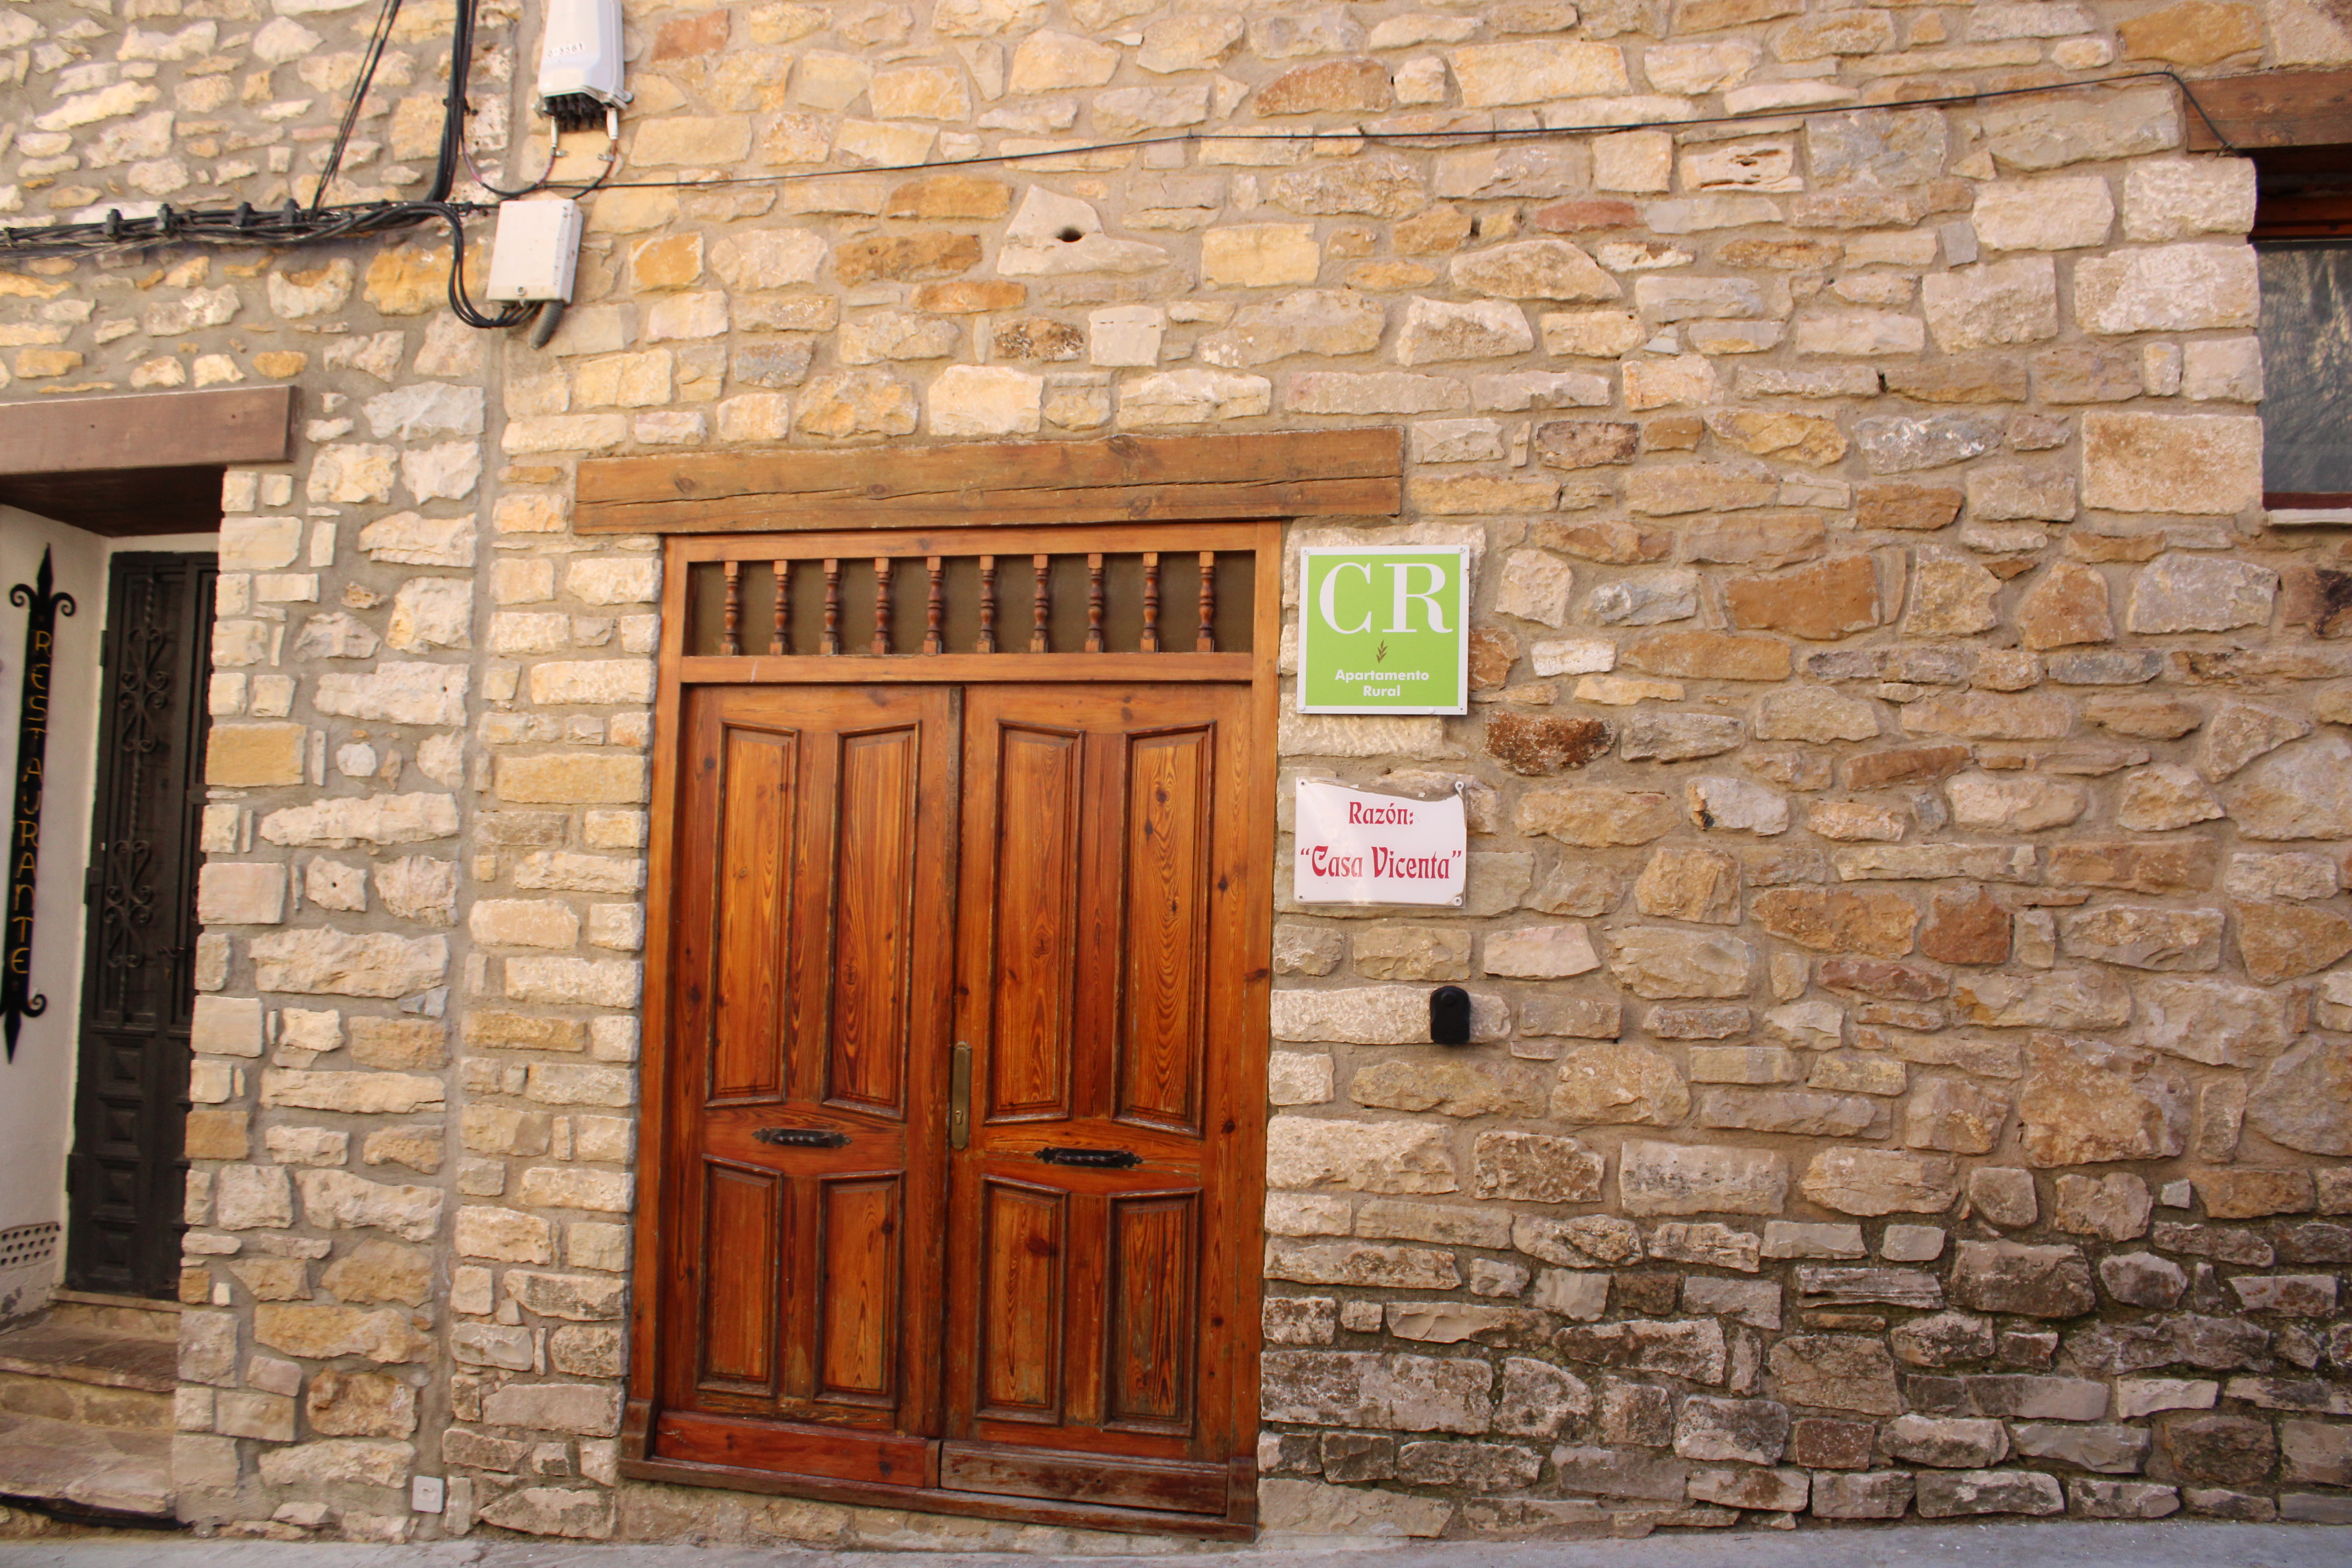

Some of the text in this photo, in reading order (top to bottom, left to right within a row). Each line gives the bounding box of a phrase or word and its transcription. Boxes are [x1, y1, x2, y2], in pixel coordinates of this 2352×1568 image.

[1319, 562, 1453, 634] CR
[1335, 669, 1430, 683] Apartamento
[1363, 685, 1401, 697] Rural
[1348, 802, 1414, 825] Razón:
